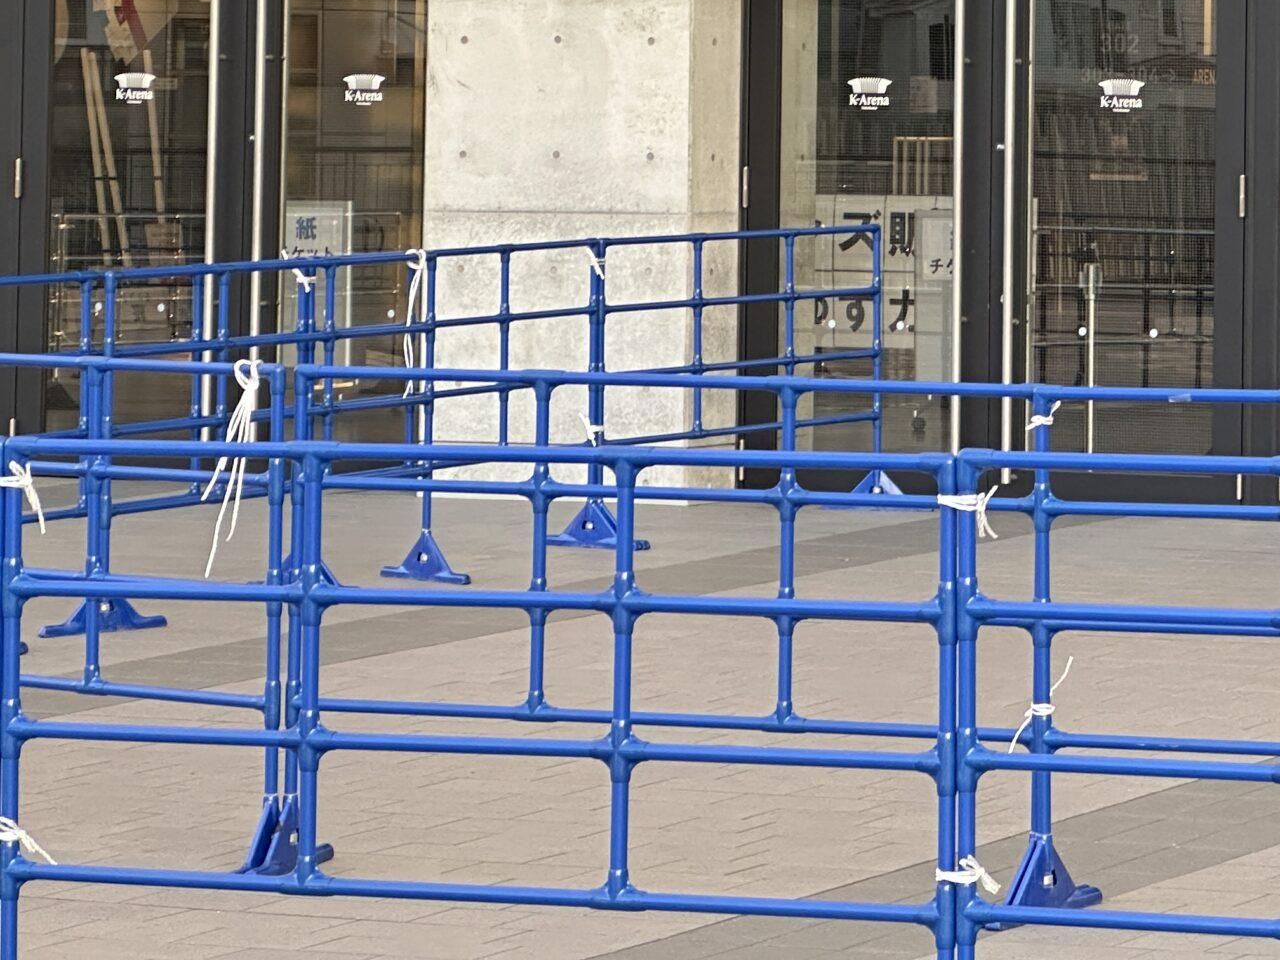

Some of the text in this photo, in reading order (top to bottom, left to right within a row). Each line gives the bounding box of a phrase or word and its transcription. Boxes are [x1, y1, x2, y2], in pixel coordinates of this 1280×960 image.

[115, 88, 153, 100] K-Arena
[345, 90, 383, 102] K-Arena
[849, 94, 889, 106] K-Arena
[1100, 96, 1142, 108] K-Arena
[296, 216, 317, 240] 紙
